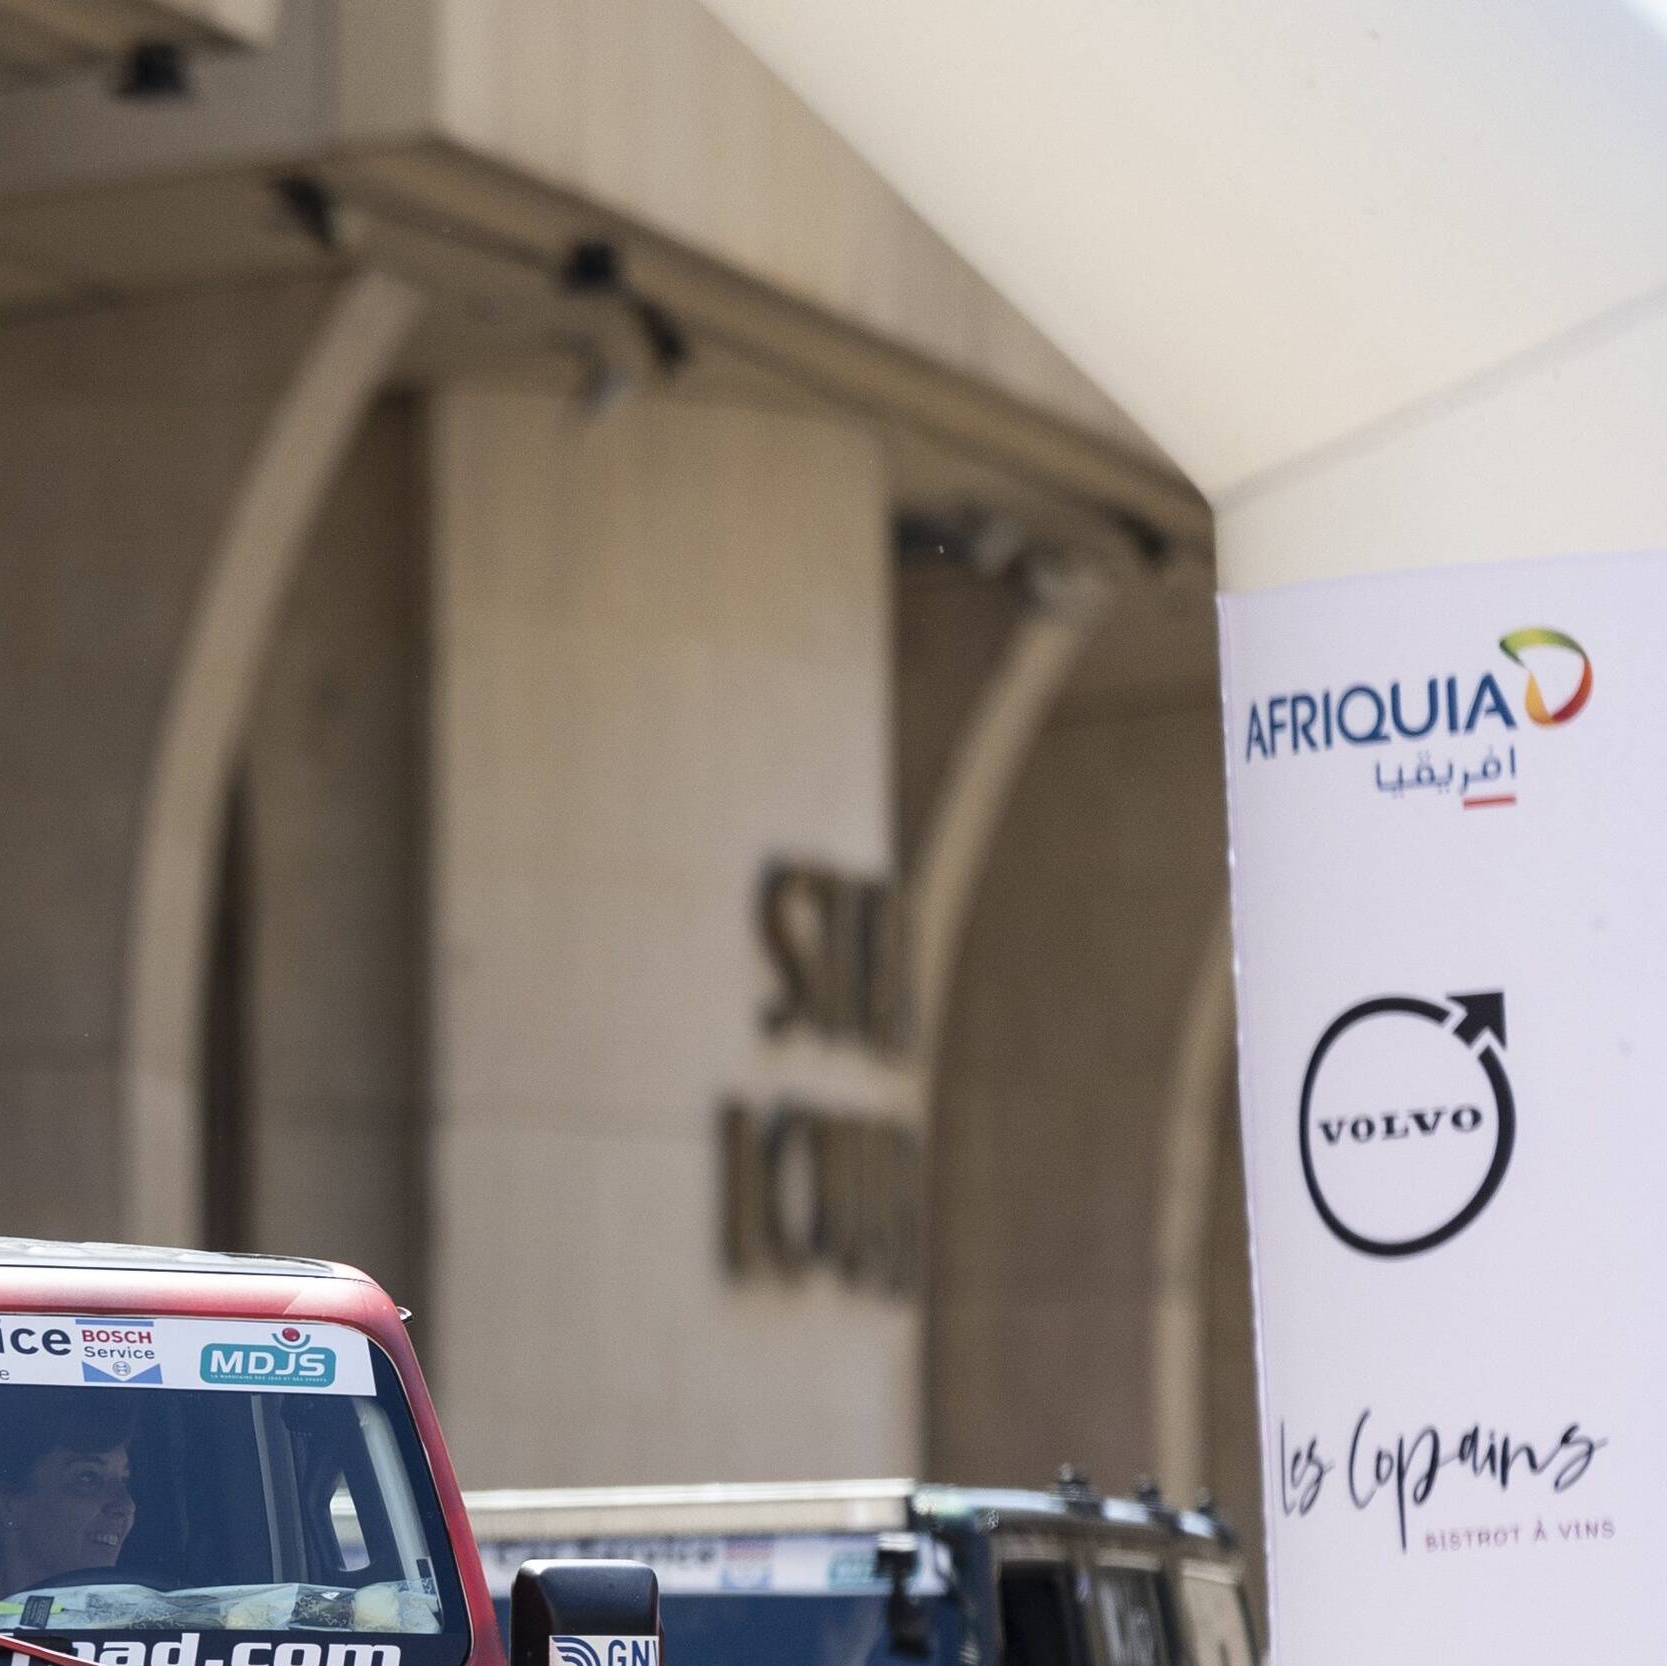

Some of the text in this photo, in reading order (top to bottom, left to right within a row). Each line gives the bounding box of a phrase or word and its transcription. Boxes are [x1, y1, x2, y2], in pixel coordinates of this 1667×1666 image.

[1246, 673, 1516, 763] AFRIQUIA
[1318, 1107, 1483, 1146] VOLVO
[82, 1330, 153, 1344] BOSCH
[84, 1346, 155, 1360] Service
[209, 1350, 326, 1377] MDJS
[1424, 1527, 1520, 1553] BISTROT
[1558, 1520, 1615, 1541] VINS
